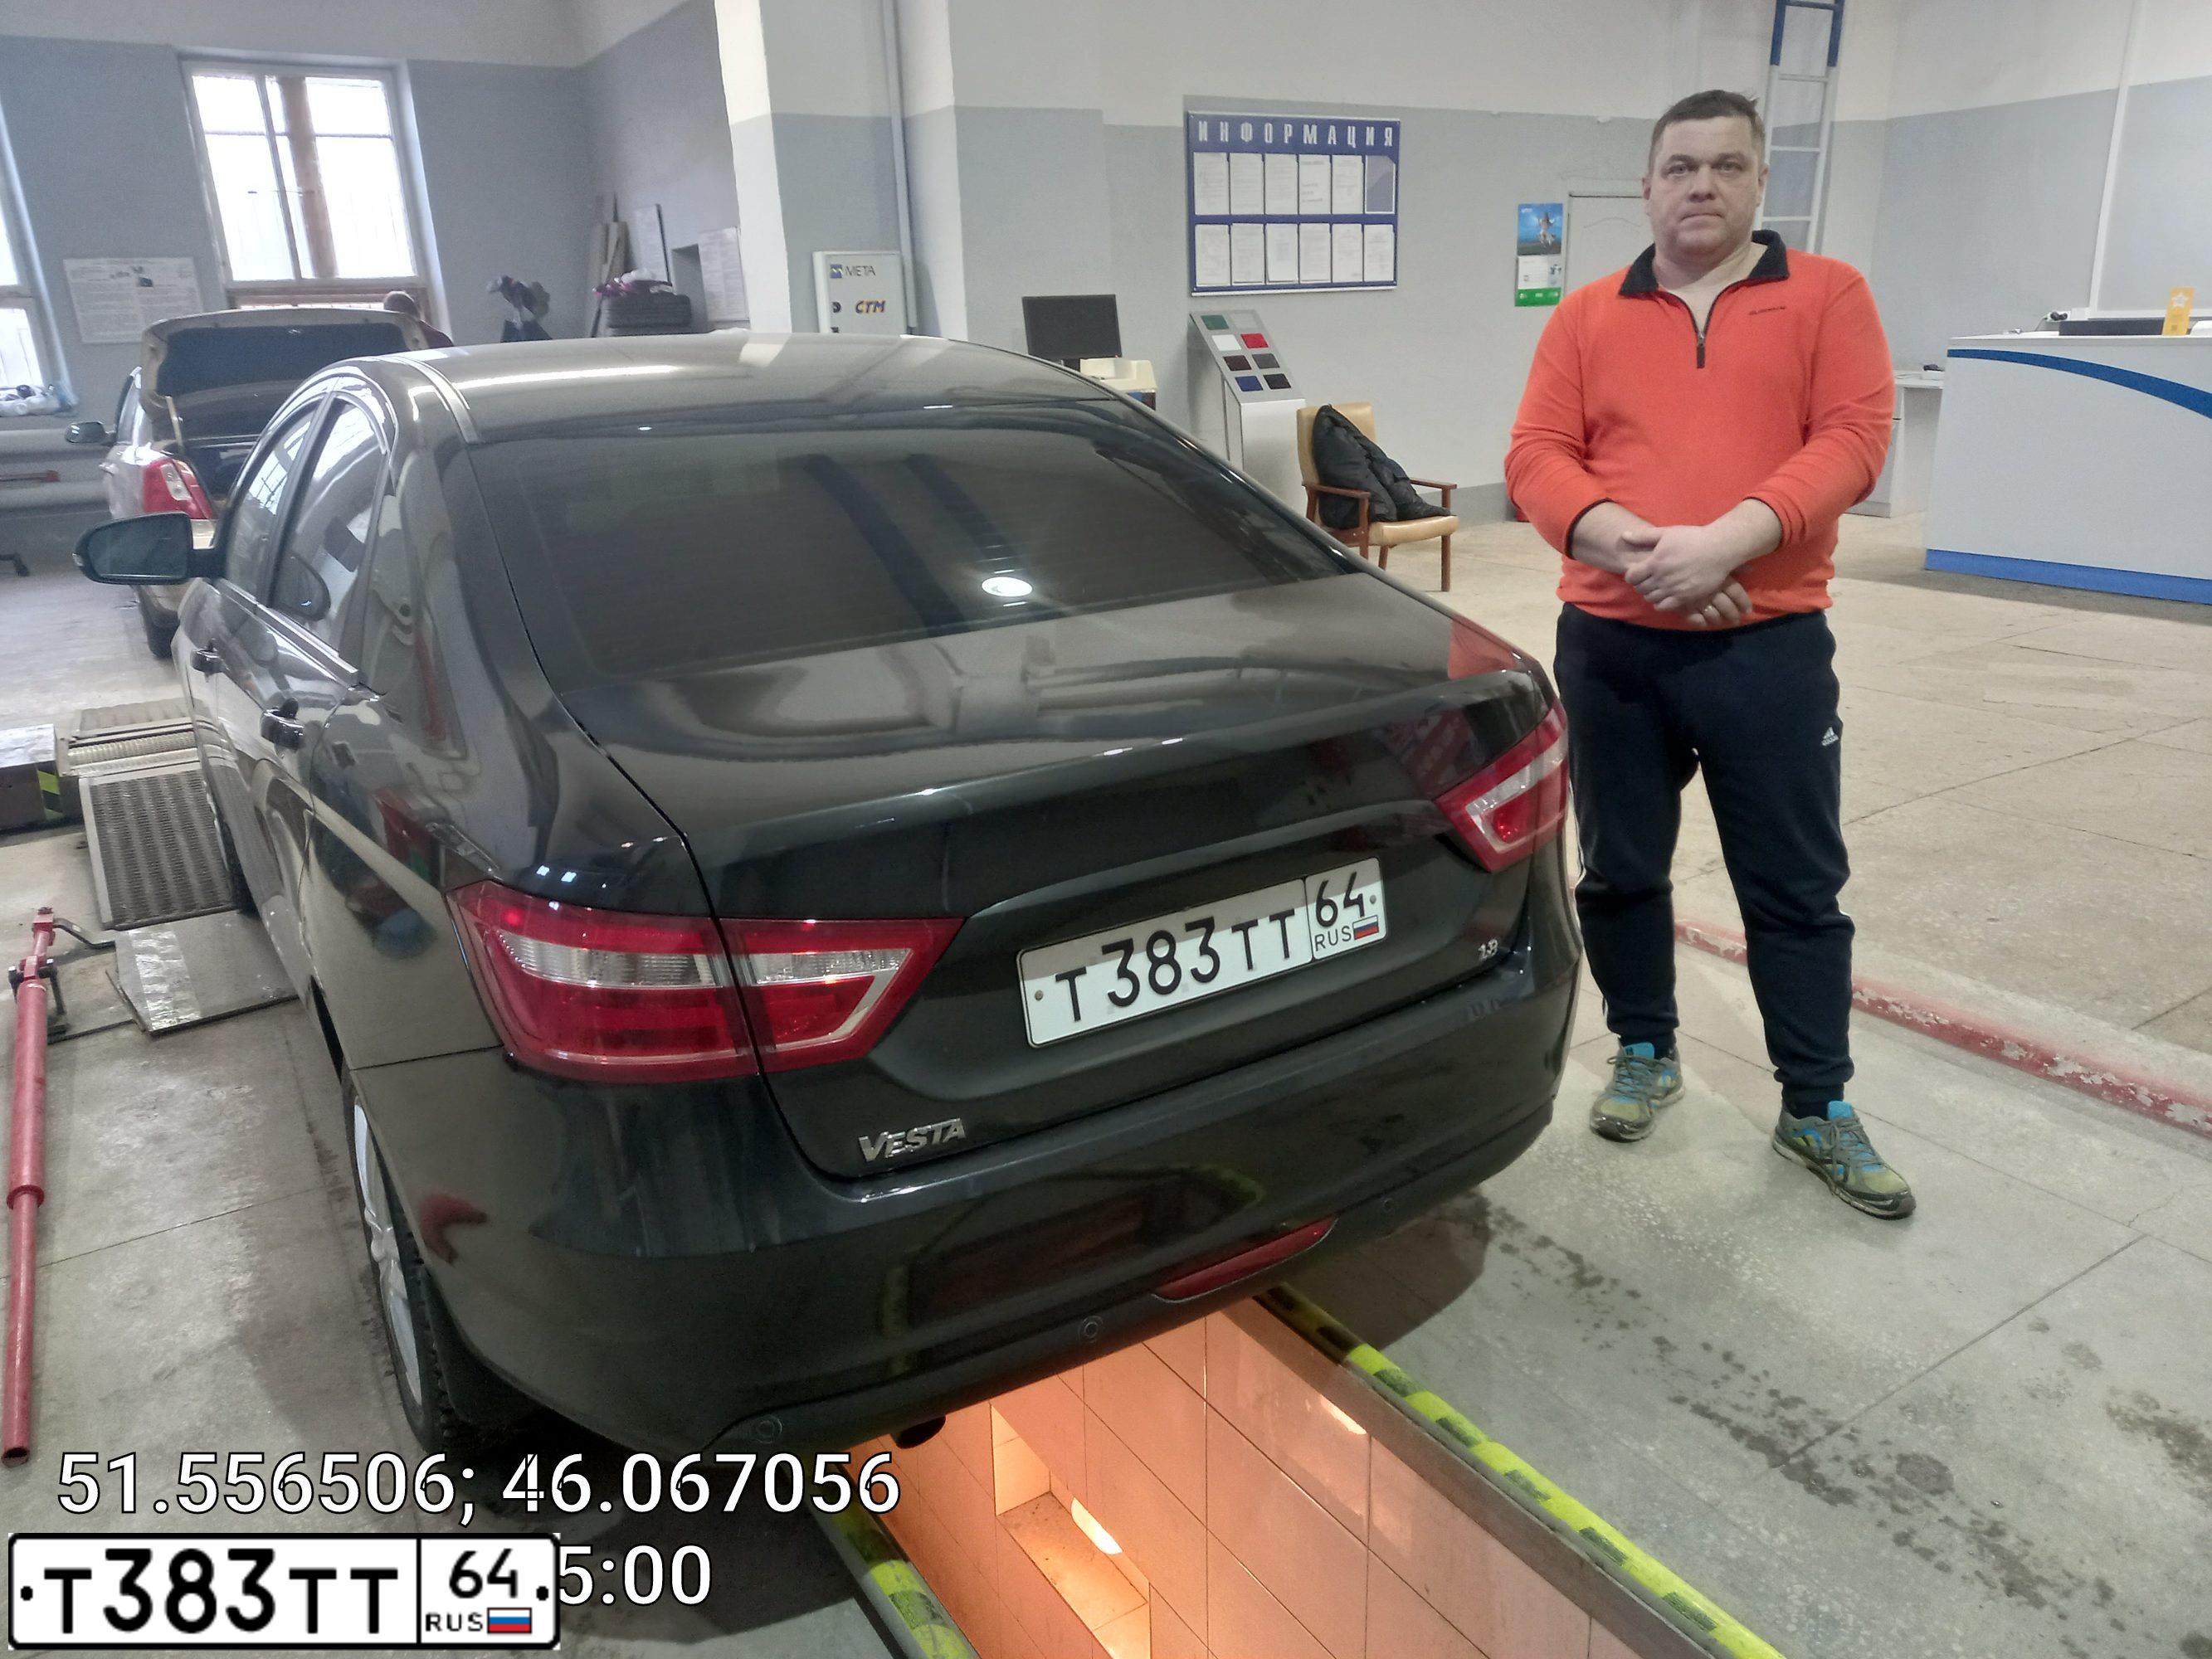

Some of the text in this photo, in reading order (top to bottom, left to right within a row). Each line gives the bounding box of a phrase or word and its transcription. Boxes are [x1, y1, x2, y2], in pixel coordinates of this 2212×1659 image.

[1197, 120, 1393, 148] ИНФОРМАЦИЯ
[1055, 871, 1366, 1022] Т383ТТ 64
[1315, 925, 1352, 951] RUS
[858, 1117, 966, 1162] VESTA
